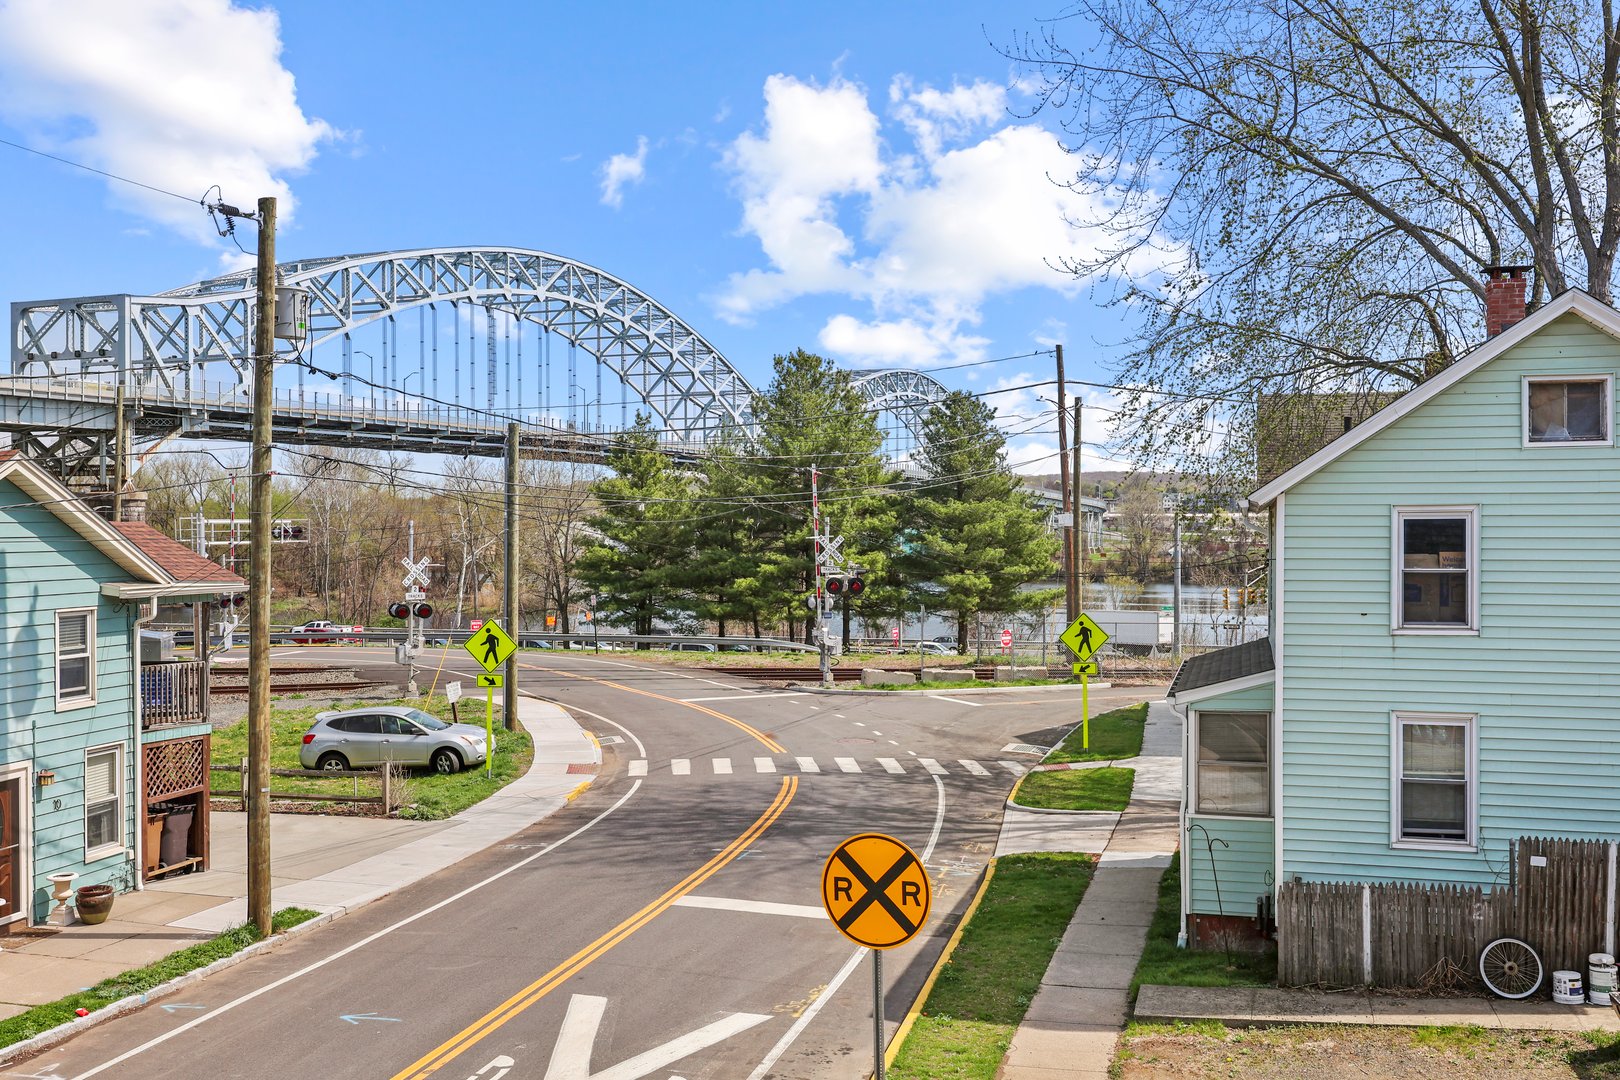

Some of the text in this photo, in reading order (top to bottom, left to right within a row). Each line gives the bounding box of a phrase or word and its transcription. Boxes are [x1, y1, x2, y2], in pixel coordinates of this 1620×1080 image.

[818, 536, 844, 562] CROSSING
[403, 558, 414, 570] RAIL
[403, 558, 429, 586] CROSSING
[417, 572, 429, 585] ROAD
[833, 876, 853, 902] R
[901, 880, 921, 907] R
